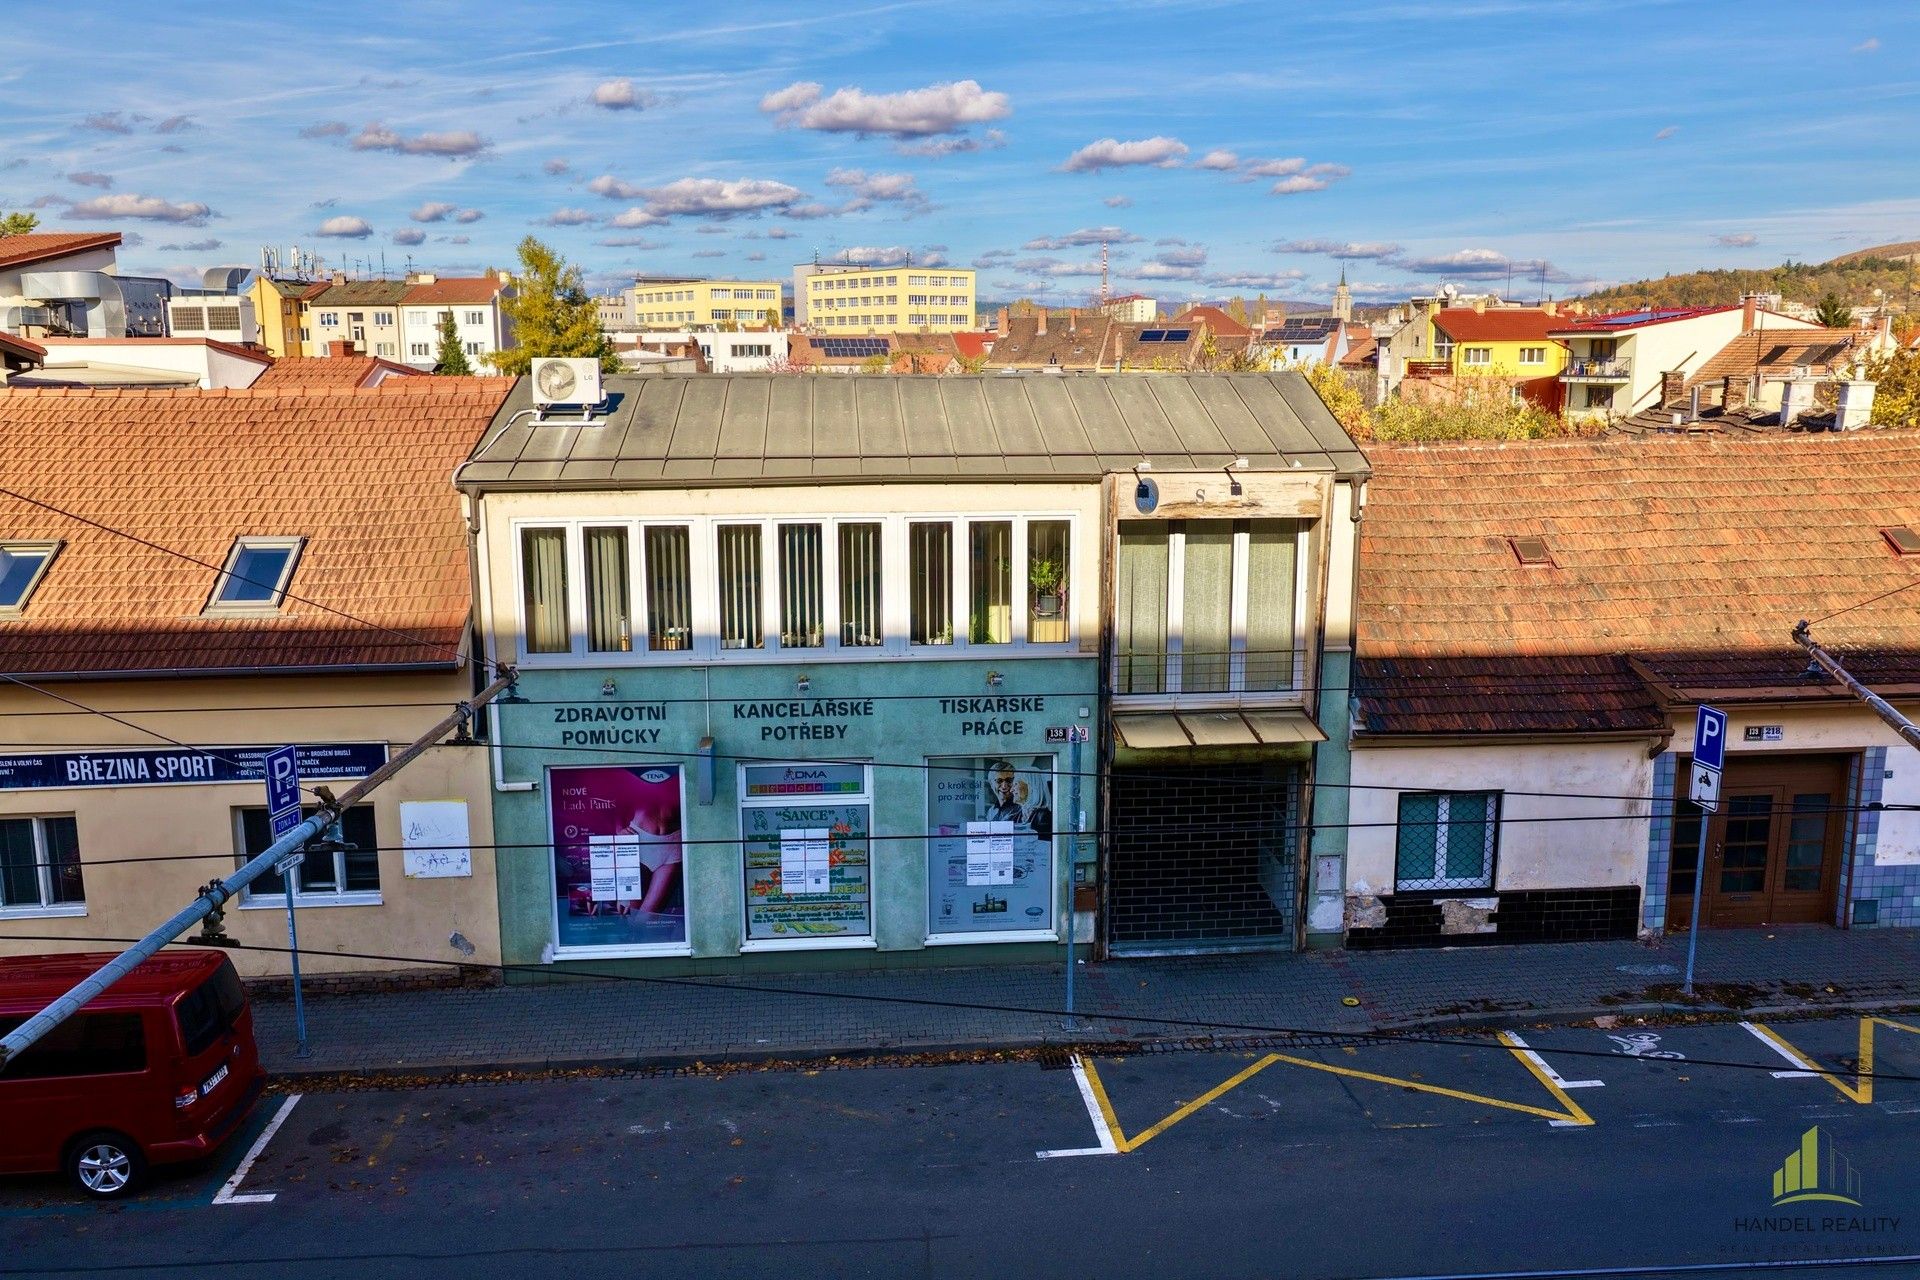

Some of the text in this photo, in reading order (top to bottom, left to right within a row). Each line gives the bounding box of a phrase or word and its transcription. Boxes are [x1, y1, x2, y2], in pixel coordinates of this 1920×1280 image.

[554, 701, 667, 722] ZDRAVOTNÍ
[733, 698, 874, 718] KANCELÁŘSKÉ
[939, 696, 1044, 713] TISKAŘSKÉ
[761, 722, 848, 740] POTŘEBY
[961, 717, 1024, 735] PRÁCE
[1050, 729, 1064, 737] 138
[1702, 715, 1719, 746] P
[561, 726, 661, 745] POMŮCKY
[66, 755, 215, 780] BŘEZINA SPORT
[274, 757, 291, 793] P
[937, 782, 945, 790] O
[947, 781, 966, 789] krok
[938, 793, 952, 803] pro
